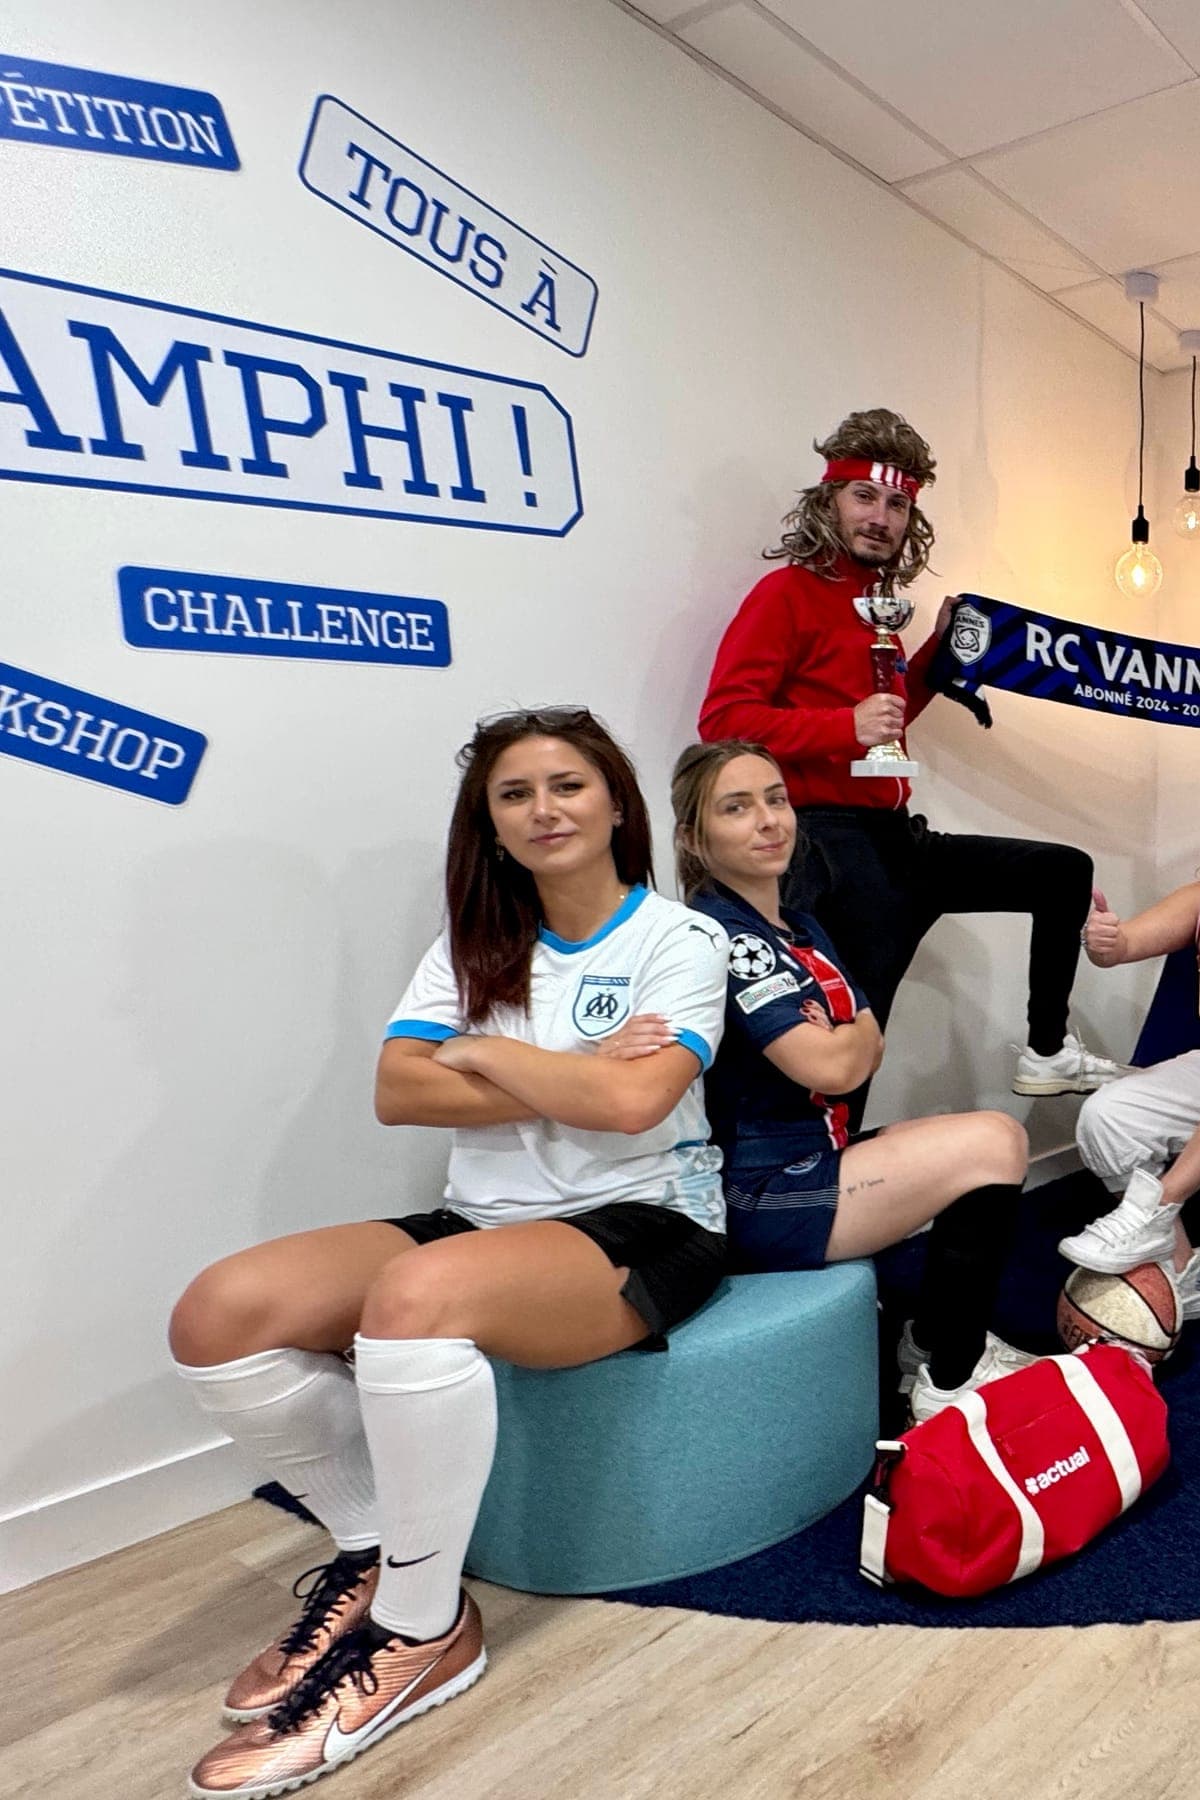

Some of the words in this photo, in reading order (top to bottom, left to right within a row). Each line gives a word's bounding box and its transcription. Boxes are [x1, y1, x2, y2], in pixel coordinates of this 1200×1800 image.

[345, 142, 508, 290] TOUS
[520, 258, 562, 333] À
[142, 586, 436, 653] CHALLENGE
[955, 614, 985, 629] ANNES
[1025, 621, 1081, 673] RC
[1073, 683, 1133, 707] ABONNÉ
[1136, 696, 1171, 713] 2024
[0, 684, 187, 780] KSHOP
[1036, 1445, 1091, 1490] actual
